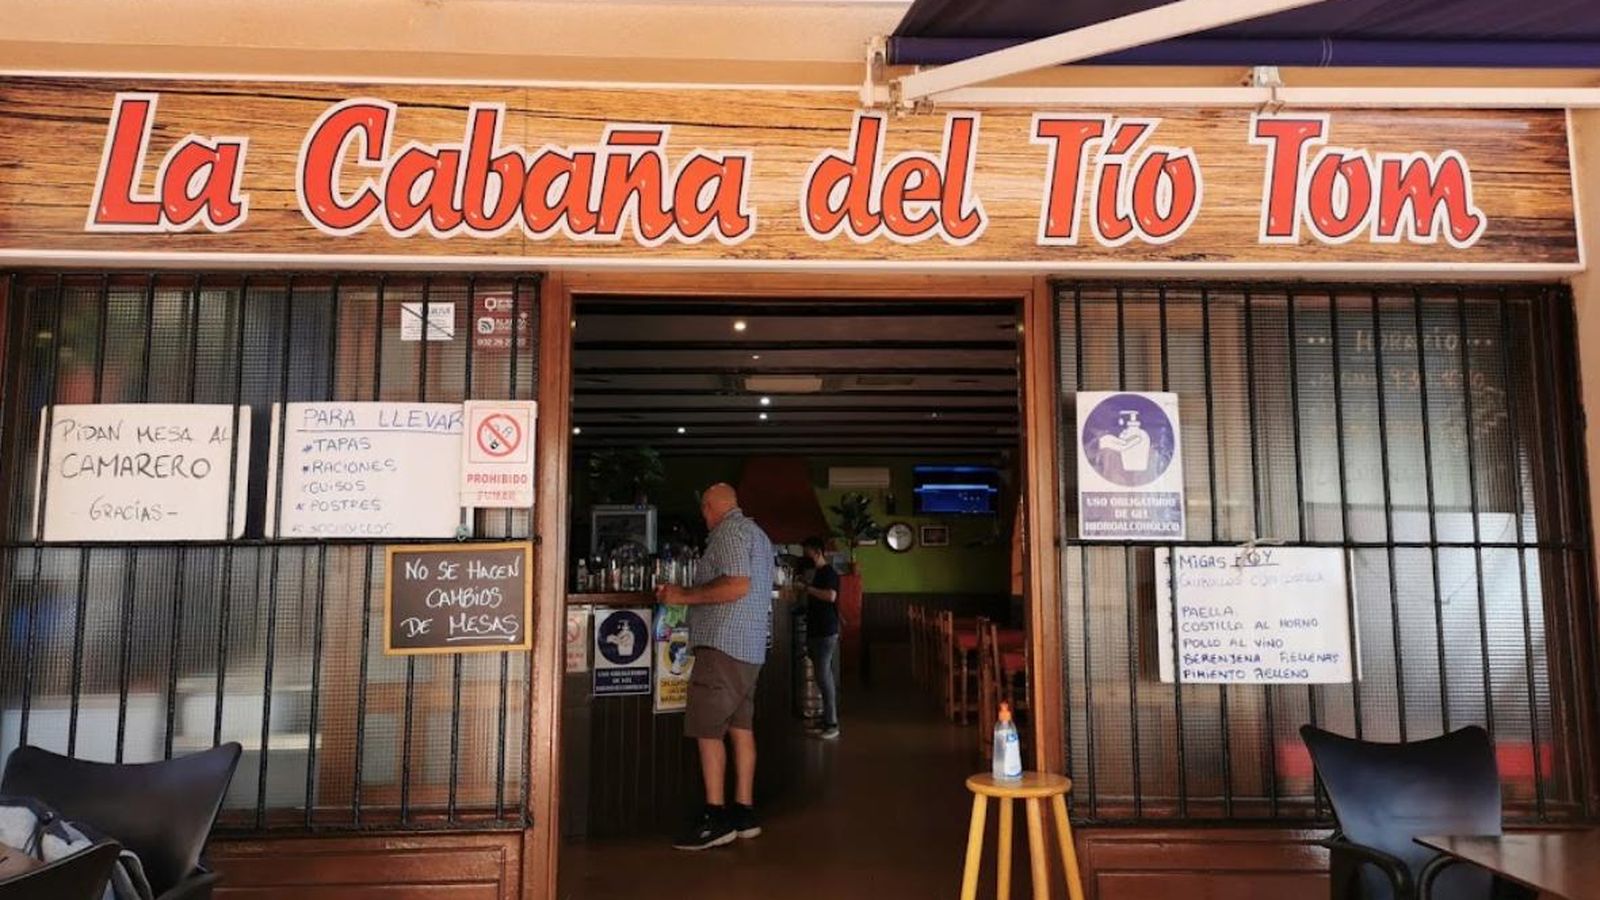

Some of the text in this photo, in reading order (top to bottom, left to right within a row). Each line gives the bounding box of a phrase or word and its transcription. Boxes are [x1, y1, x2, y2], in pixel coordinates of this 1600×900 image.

[84, 92, 1487, 248] La Cabaña del Tío Tom
[304, 408, 355, 427] PARA
[137, 426, 193, 442] MESA
[314, 437, 371, 451] TAPAS
[61, 453, 211, 479] CAMARERO
[312, 459, 397, 473] RACIONES
[467, 474, 528, 484] PROHIBIDO
[310, 499, 382, 512] POSTRES
[1086, 496, 1176, 507] USO OBLIGATORIO
[1114, 509, 1148, 518] DE GEL
[405, 556, 520, 580] NO SE HACEN
[1179, 555, 1226, 569] MIGAS
[426, 586, 502, 608] CAMBIOS
[1182, 606, 1233, 619] PAELLA
[401, 613, 519, 637] DE MESAS
[1181, 618, 1318, 633] COSTILLA AL HORNO
[1182, 638, 1221, 648] POLLO
[1230, 638, 1247, 648] AL
[1182, 653, 1261, 665] BERENJENA
[1182, 668, 1245, 680] PIMIENTO
